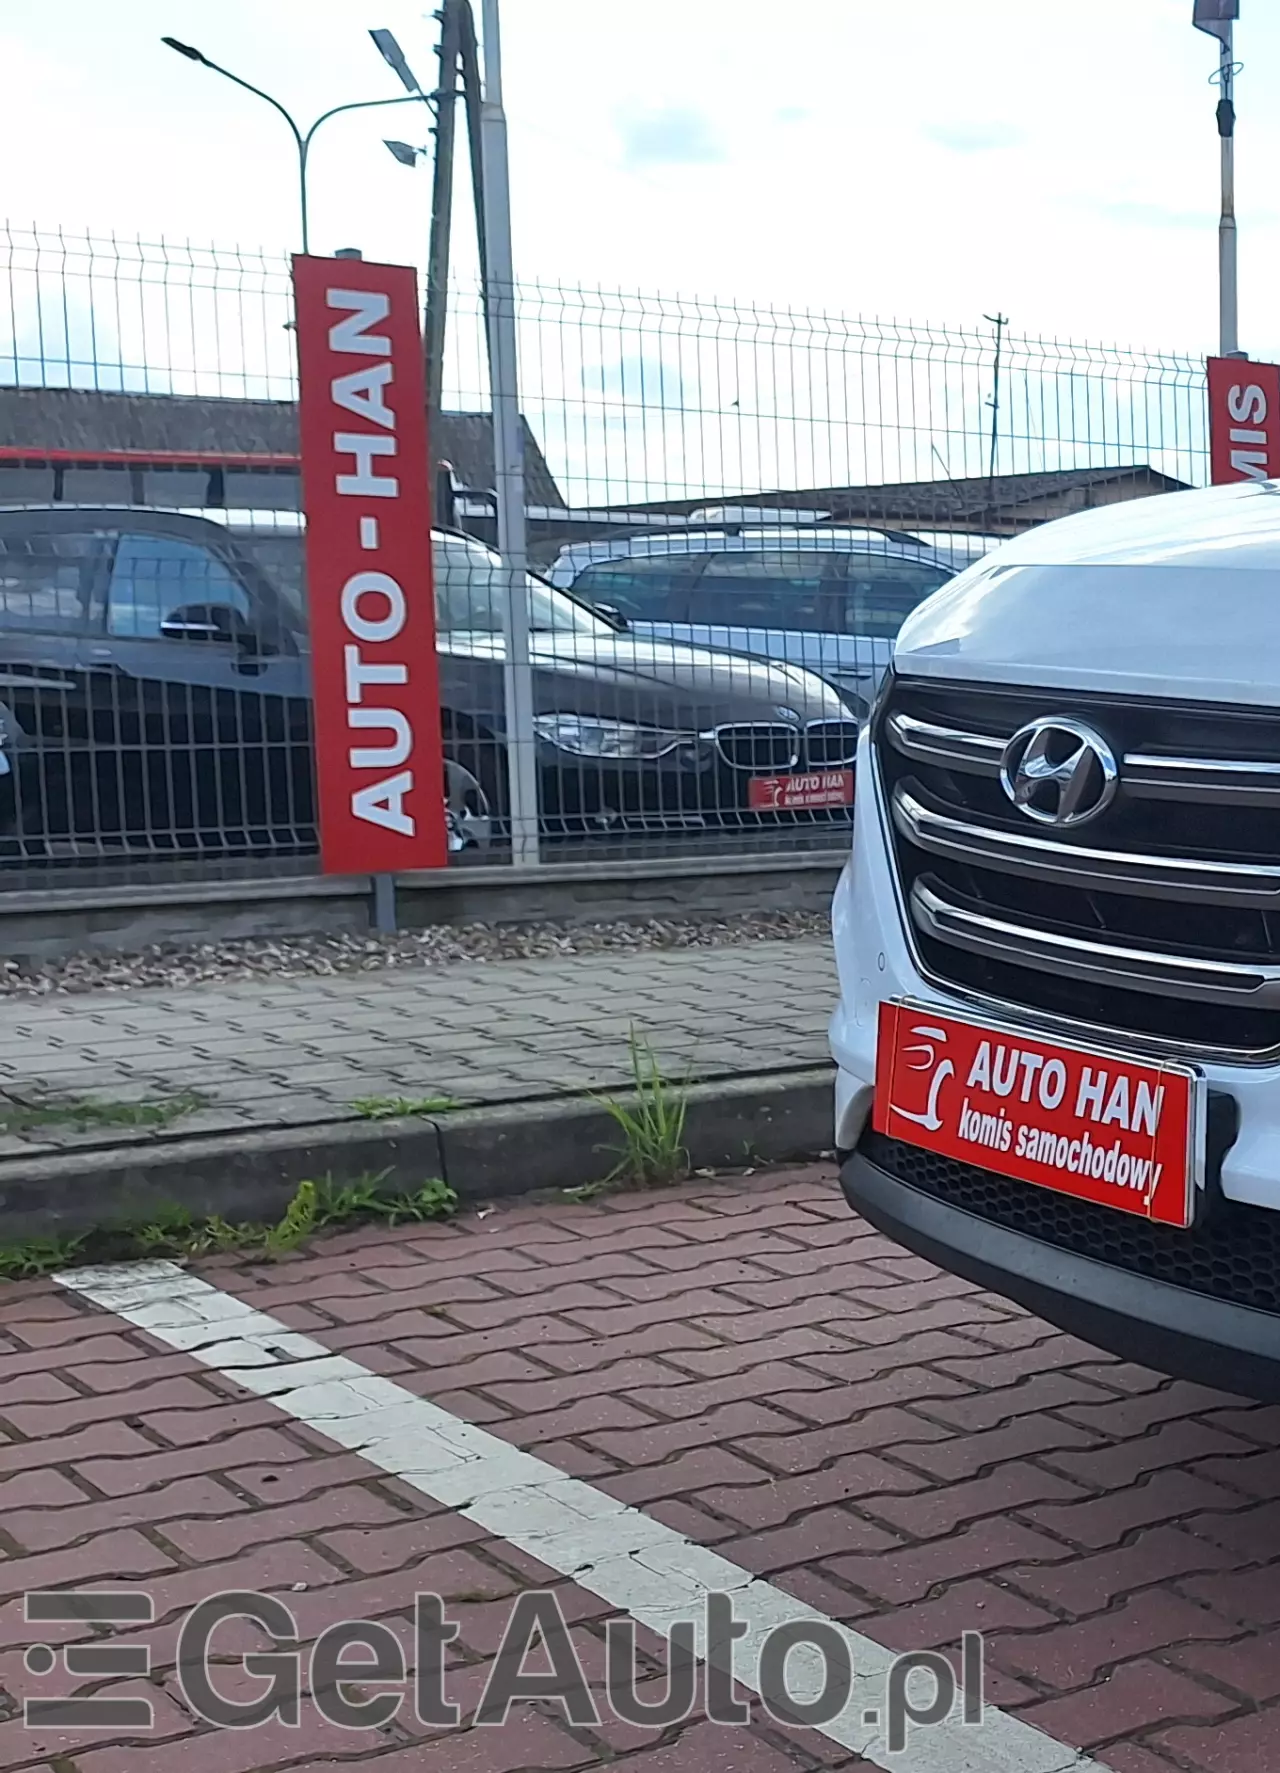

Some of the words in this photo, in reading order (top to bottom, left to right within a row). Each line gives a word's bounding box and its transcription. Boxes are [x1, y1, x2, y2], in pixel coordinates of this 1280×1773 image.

[326, 287, 400, 499] HAN
[340, 569, 416, 838] AUTO
[785, 775, 820, 792] AUTO
[966, 1040, 1067, 1110] AUTO
[1075, 1066, 1165, 1137] HAN
[957, 1098, 1013, 1152] komis
[1014, 1125, 1162, 1206] samochodowy
